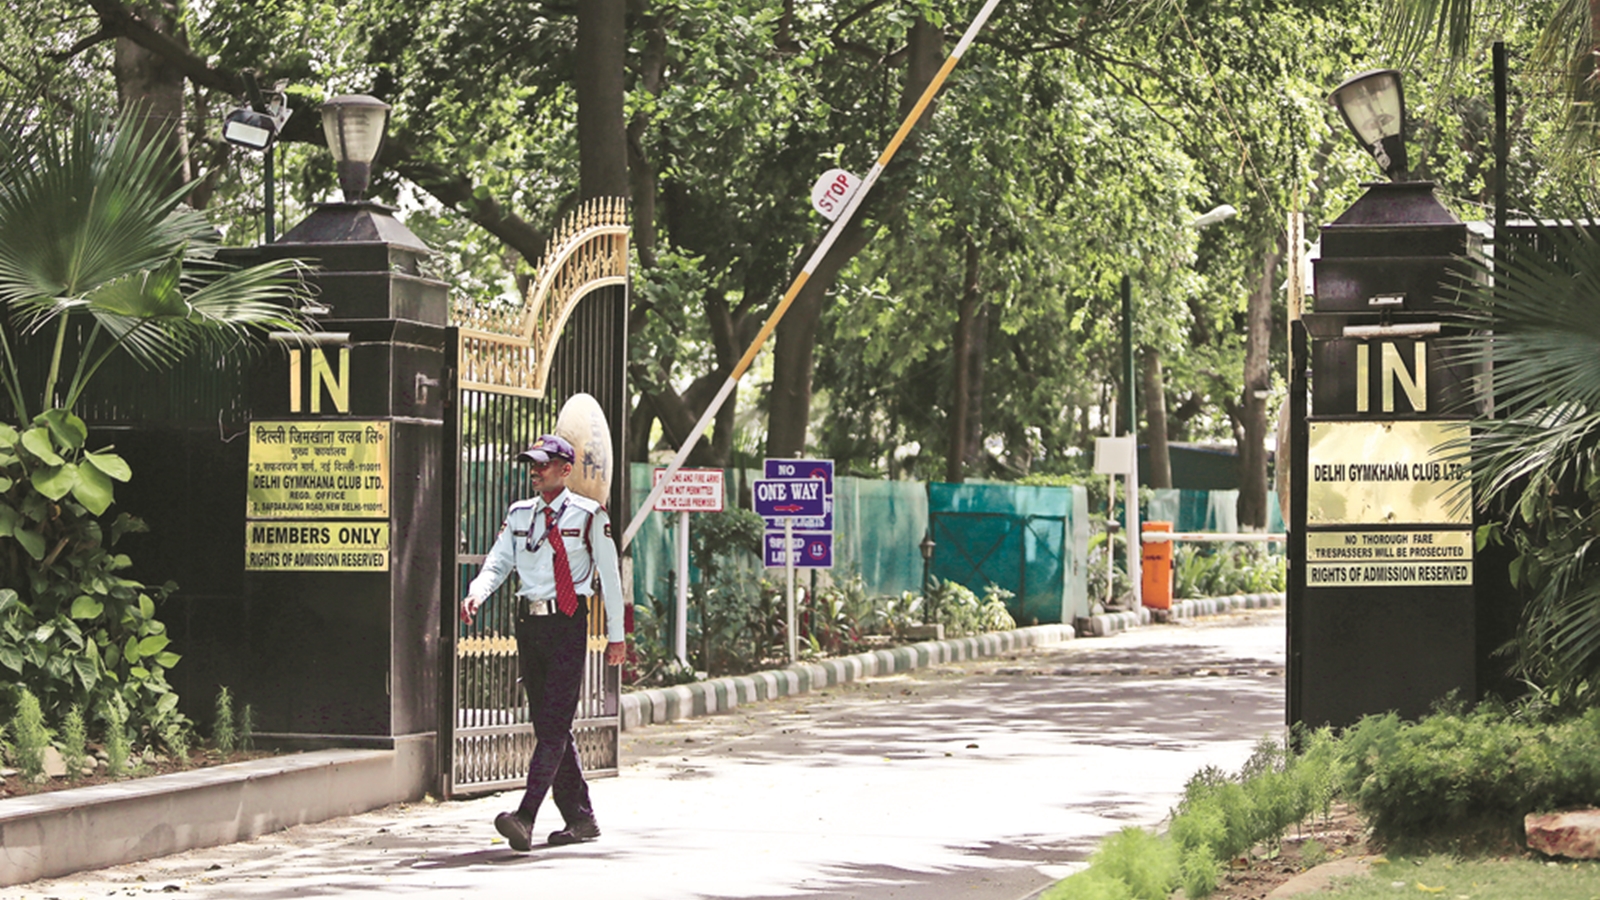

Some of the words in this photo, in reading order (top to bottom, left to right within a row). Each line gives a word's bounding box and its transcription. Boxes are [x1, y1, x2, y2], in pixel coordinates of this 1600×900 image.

[818, 174, 849, 212] STOP
[290, 348, 350, 413] IN
[1357, 342, 1426, 412] IN
[256, 426, 285, 444] दिल्ली
[778, 464, 795, 476] NO
[1314, 464, 1345, 482] DELHI
[1349, 464, 1409, 481] GYMKHANA
[1412, 463, 1441, 481] CLUB
[254, 476, 280, 489] DELHI
[284, 476, 335, 489] GYMKHANA
[337, 476, 361, 489] CLUB
[365, 476, 384, 489] LTD.
[315, 491, 346, 500] OFFICE
[758, 484, 787, 501] ONE
[790, 483, 819, 500] WAY
[252, 528, 330, 544] MEMBERS
[338, 528, 380, 544] ONLY
[769, 537, 805, 549] SPED
[1345, 535, 1357, 545] NO
[1362, 535, 1408, 544] THOROUGH
[1413, 534, 1433, 544] FARE
[250, 553, 280, 567] RIGHTS
[282, 553, 292, 566] OF
[294, 553, 339, 566] ADMISSION
[342, 553, 384, 566] RESERVED
[1316, 548, 1373, 558] TRESPASSERS
[1375, 547, 1394, 557] WILL
[1397, 547, 1407, 557] BE
[1410, 546, 1464, 557] PROSECUTED
[1311, 567, 1347, 582] RIGHTS
[1350, 567, 1362, 582] OF
[1363, 567, 1416, 582] ADMISSION
[1418, 566, 1468, 580] RESERVED
